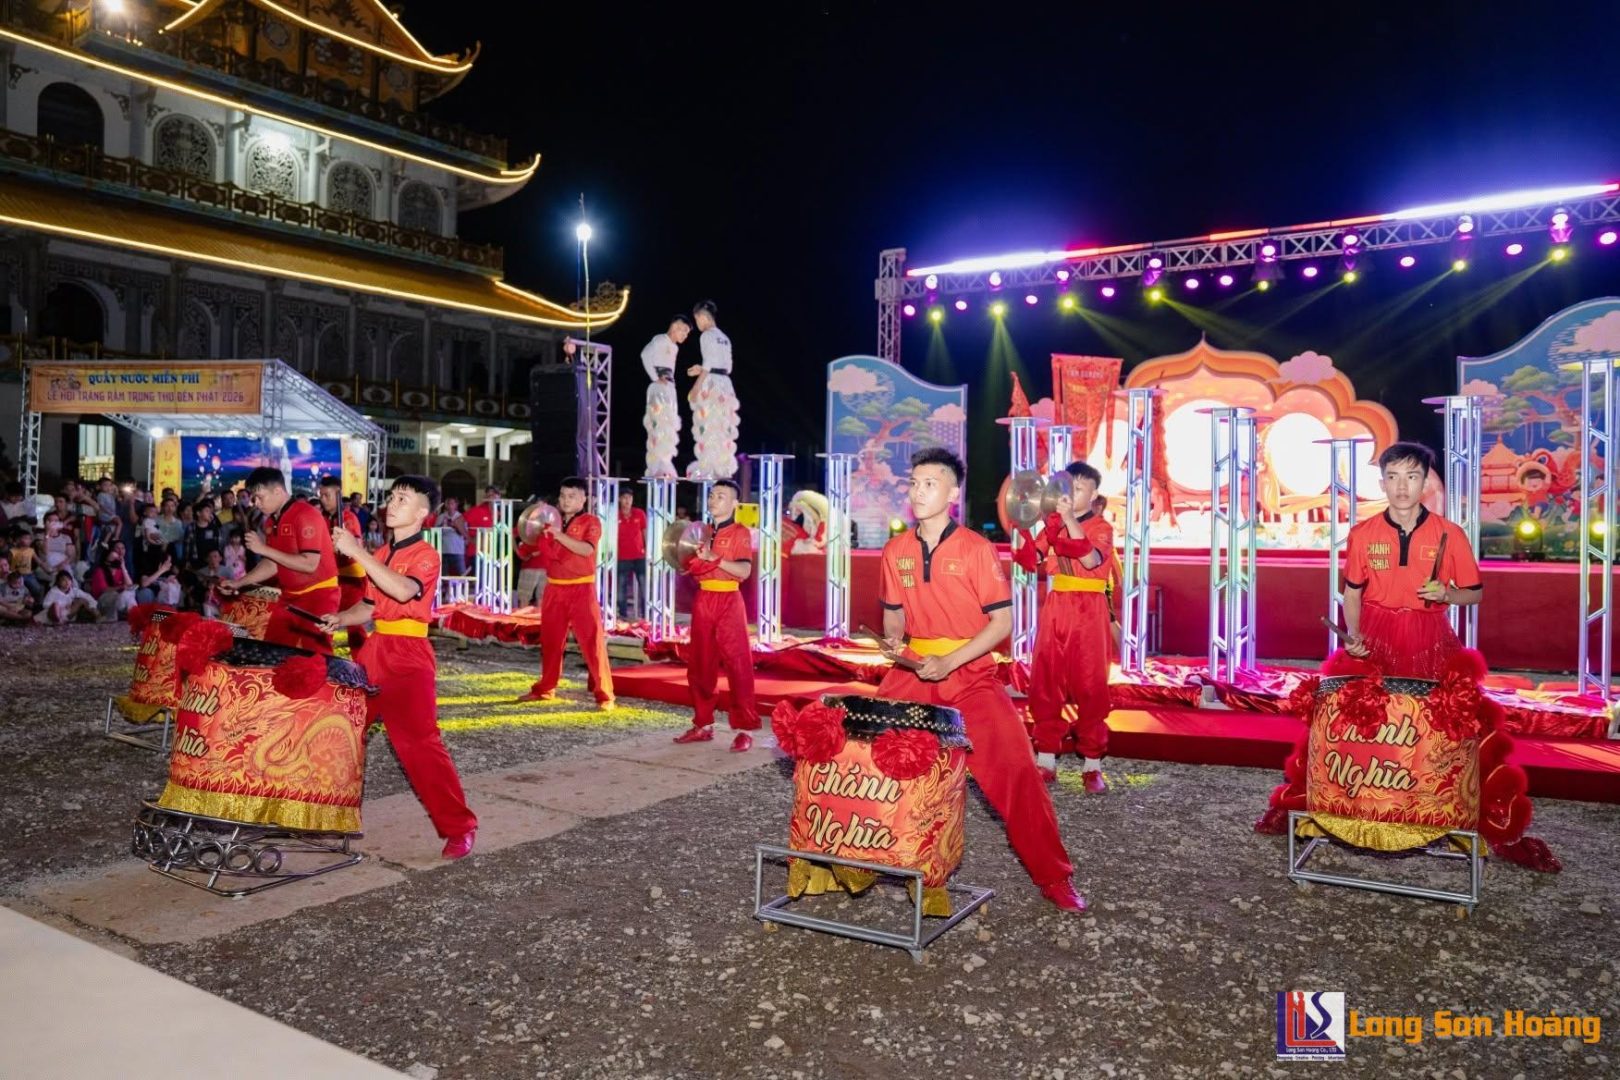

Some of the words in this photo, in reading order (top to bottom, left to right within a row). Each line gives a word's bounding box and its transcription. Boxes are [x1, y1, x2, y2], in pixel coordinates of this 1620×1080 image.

[1325, 708, 1419, 748] Cnh
[808, 761, 903, 804] Chánh
[1324, 750, 1418, 798] Nghĩa
[805, 803, 898, 855] Nghĩa
